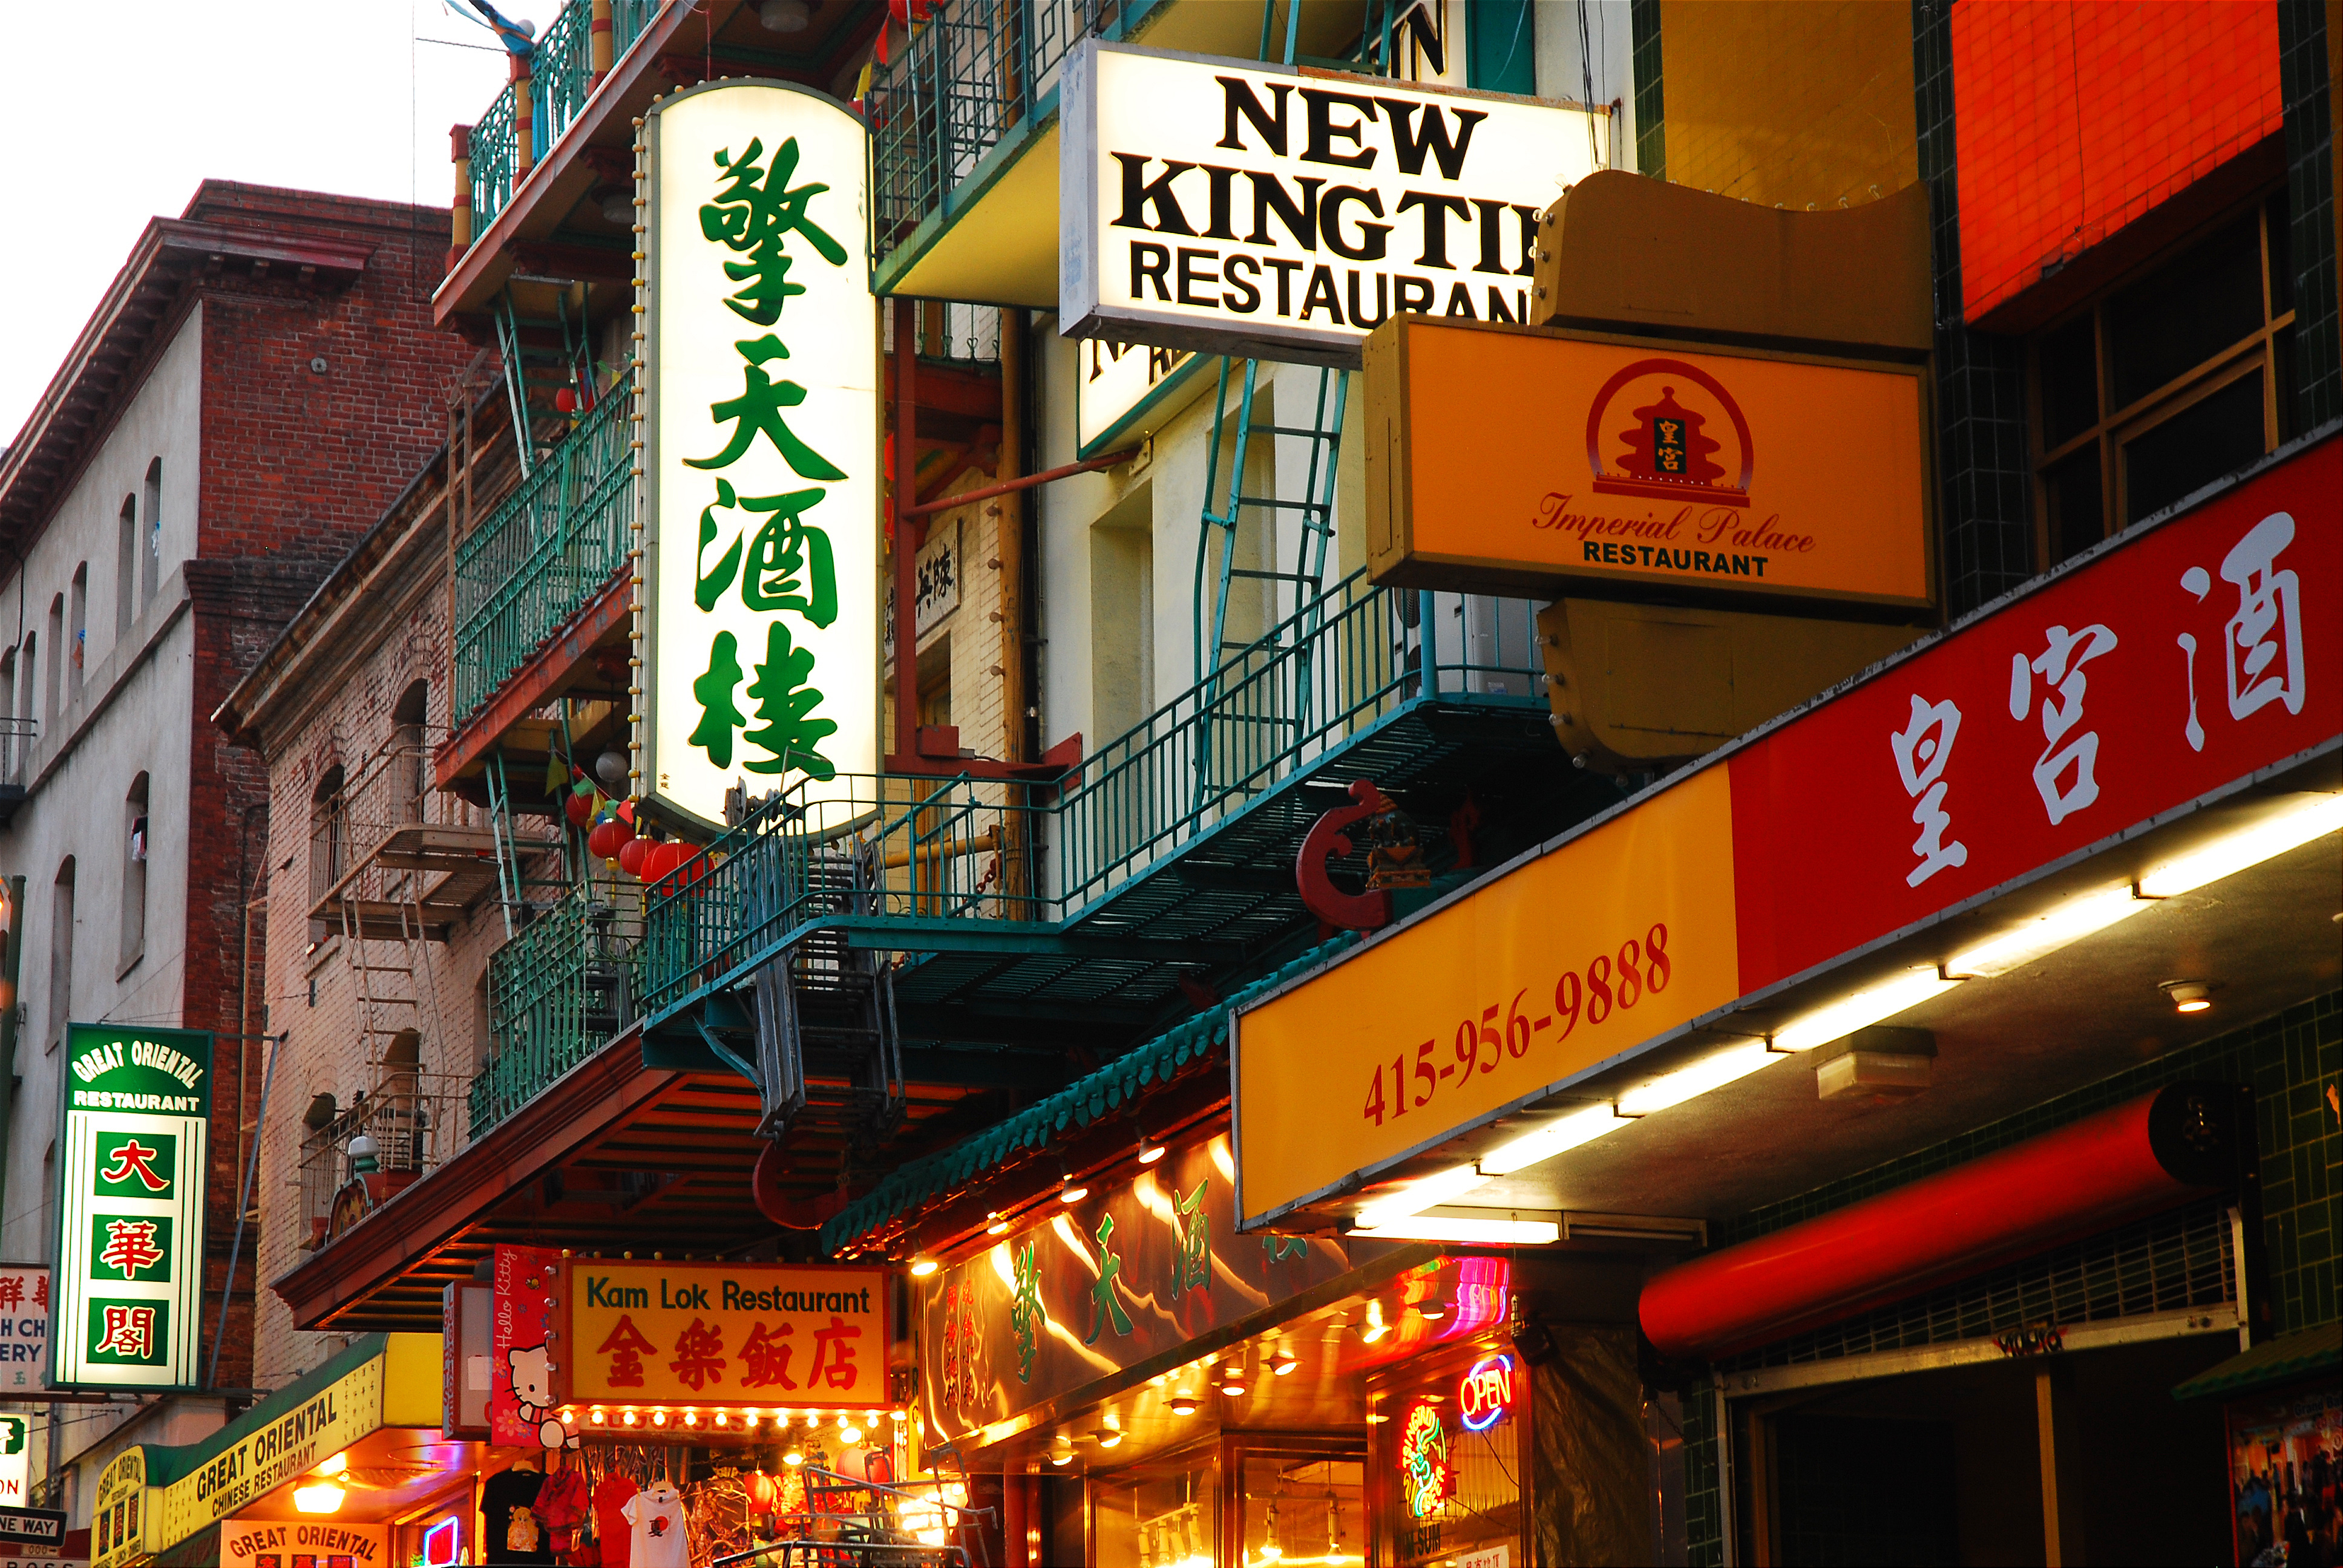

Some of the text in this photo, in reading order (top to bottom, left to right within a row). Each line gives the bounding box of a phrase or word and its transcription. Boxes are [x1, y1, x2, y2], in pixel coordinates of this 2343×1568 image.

[1215, 75, 1489, 180] NEW
[1130, 240, 1527, 330] RESTAURAN
[1658, 419, 1682, 471] 皇宮
[1532, 492, 1815, 552] Imperial Palace
[1584, 541, 1768, 577] RESTAURANT
[1889, 511, 2305, 889] 皇宮酒
[1363, 922, 1672, 1126] 415-956-9888
[72, 1040, 203, 1089] GREAT ORIENTAL
[74, 1090, 199, 1112] RESTAURANT
[95, 1139, 170, 1359] 大華閣
[496, 1249, 517, 1349] Hello Kitty
[587, 1276, 870, 1313] Kam Lok Restaurant
[597, 1314, 862, 1391] 金樂飯店
[1460, 1368, 1511, 1417] OPEN
[197, 1445, 247, 1502] GREAT
[254, 1393, 337, 1467] ORIENTAL
[212, 1480, 250, 1517] CHINESE
[254, 1440, 316, 1493] RESTAURANT
[24, 1519, 54, 1535] WAY
[229, 1525, 378, 1561] GREAT ORIENTAL
